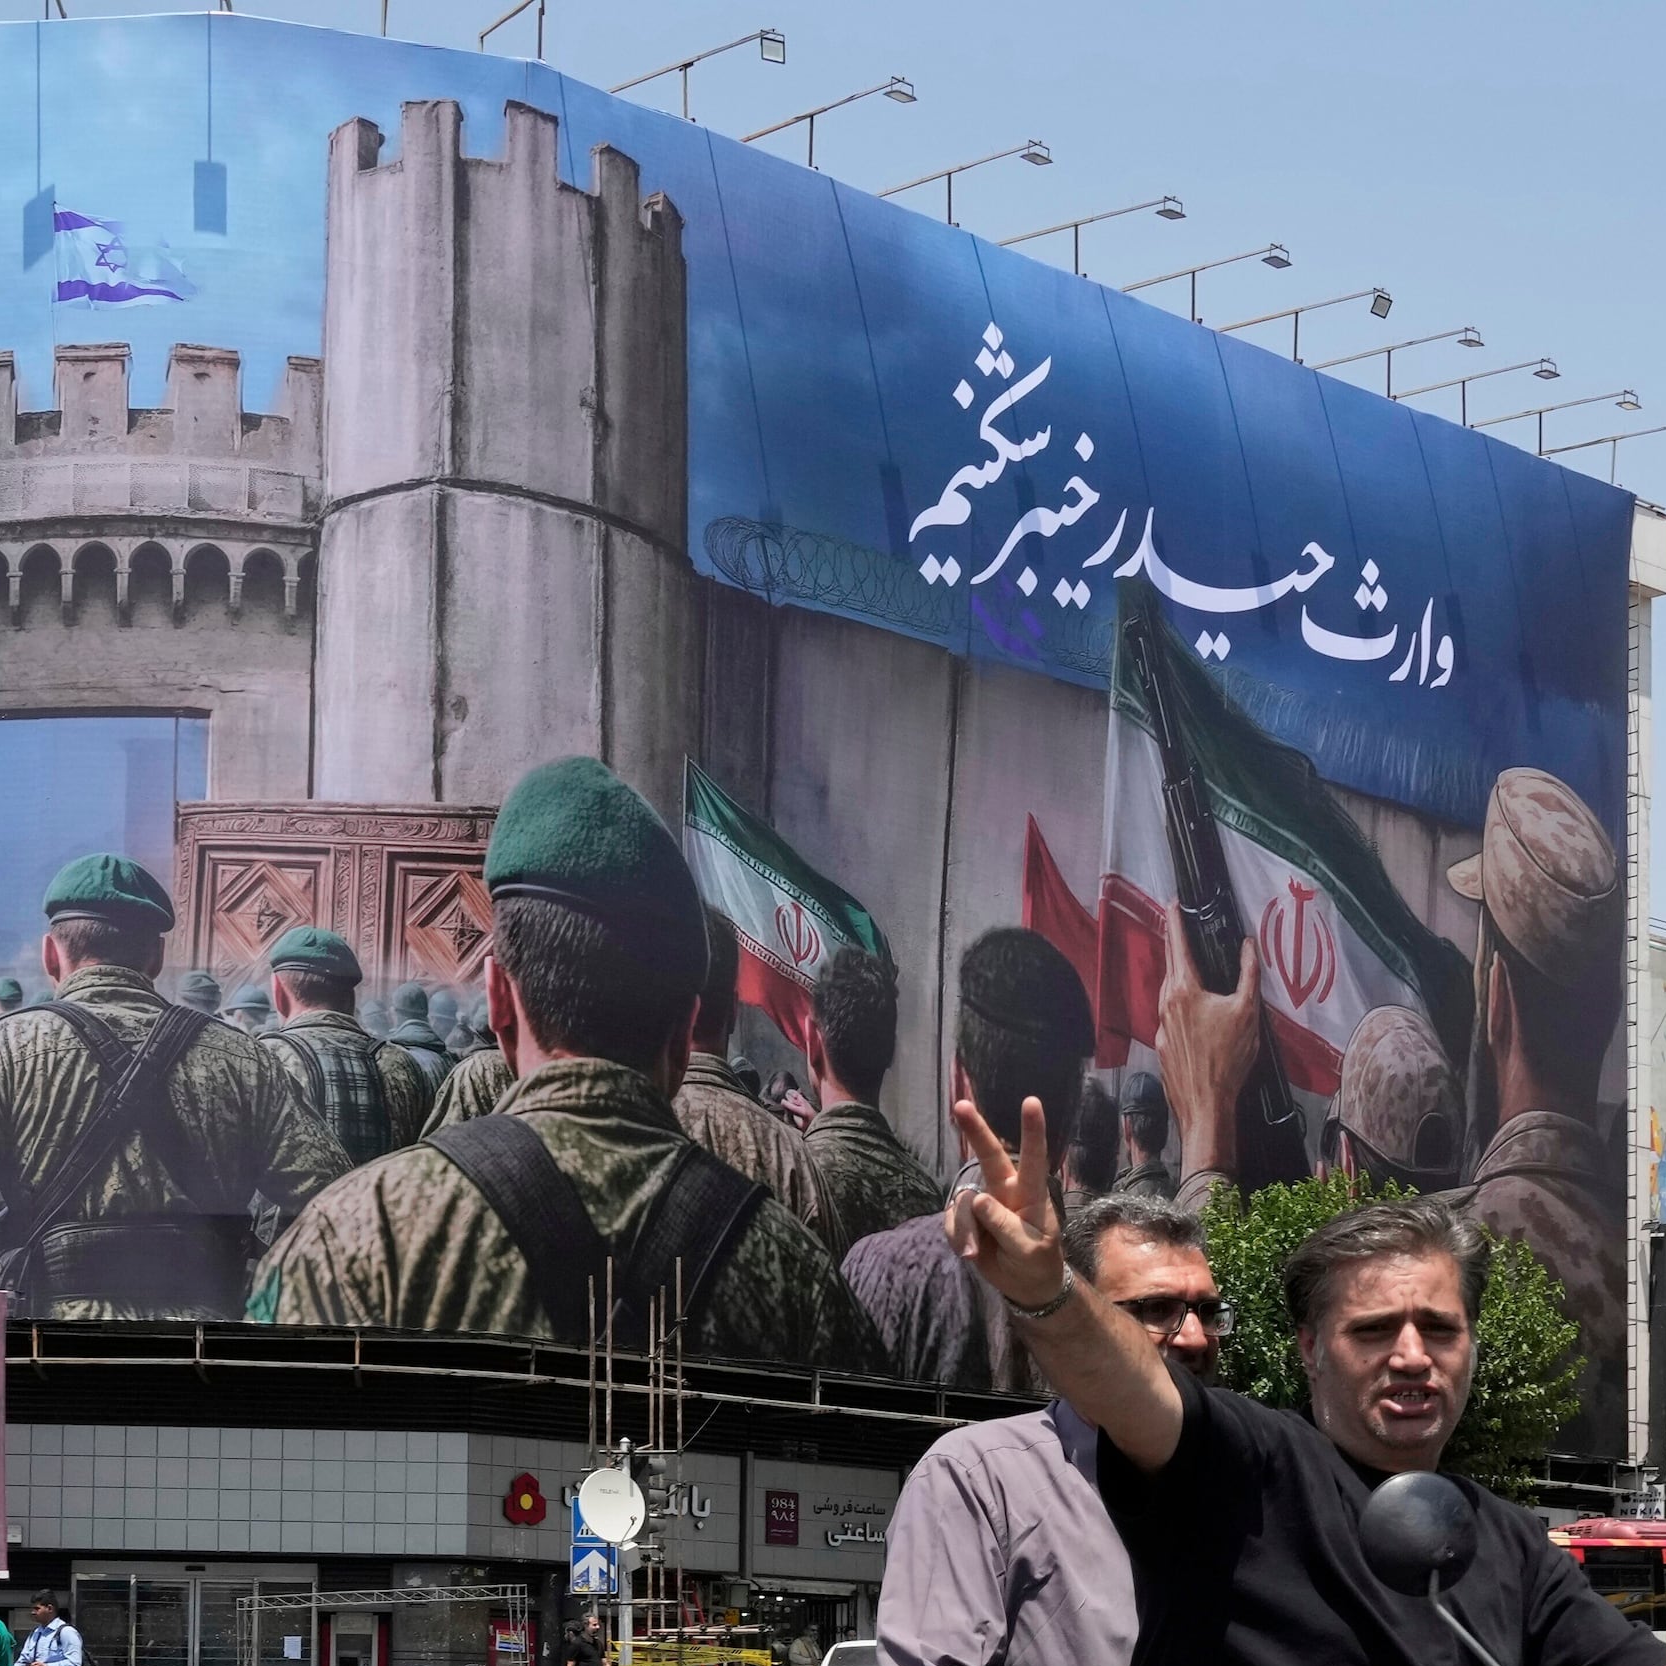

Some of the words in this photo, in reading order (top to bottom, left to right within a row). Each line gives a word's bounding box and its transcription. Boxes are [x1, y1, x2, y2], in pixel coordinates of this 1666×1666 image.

[971, 431, 1100, 610] خیبر
[1083, 506, 1336, 661] حیدر
[1301, 558, 1456, 688] وارث
[771, 1497, 796, 1510] 984
[1620, 1507, 1661, 1516] NOKIA
